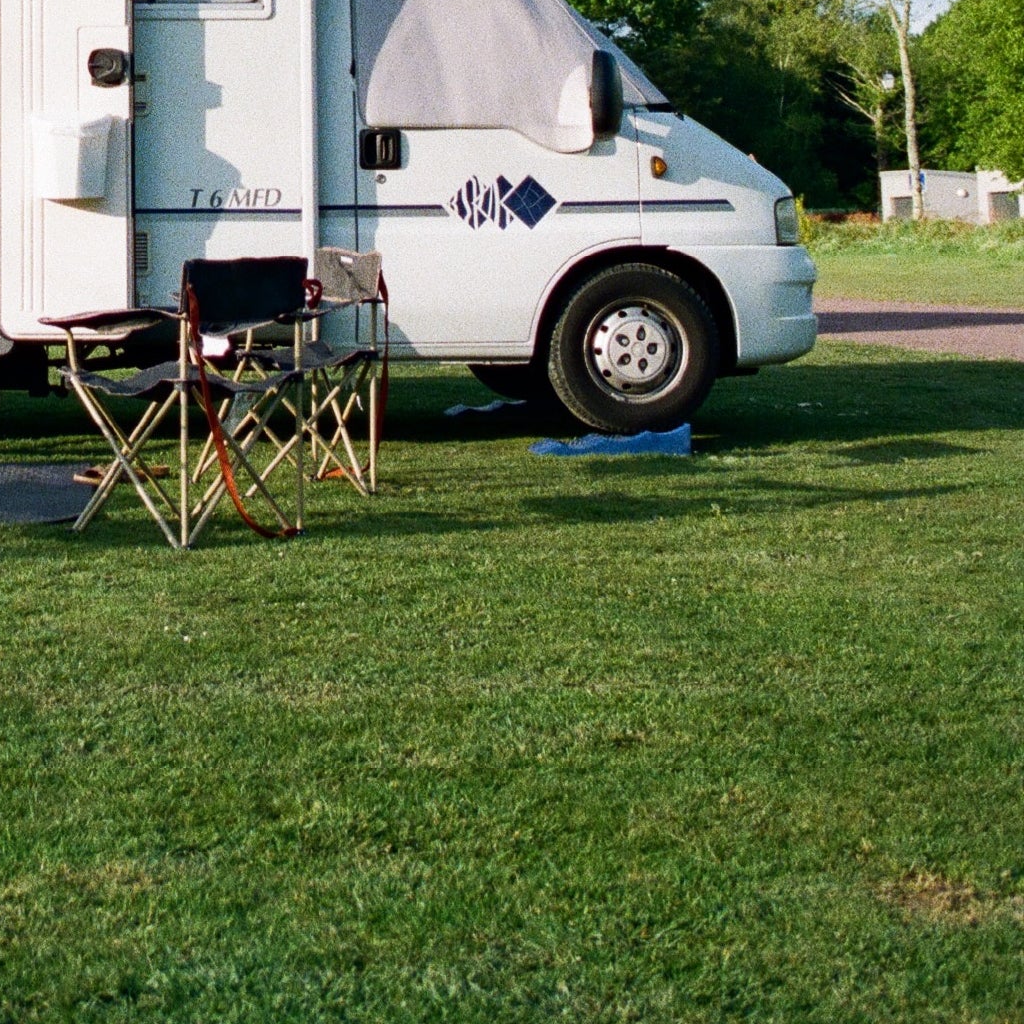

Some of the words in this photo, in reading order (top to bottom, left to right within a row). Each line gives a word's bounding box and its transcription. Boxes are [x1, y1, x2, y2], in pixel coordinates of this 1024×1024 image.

[190, 188, 204, 208] T
[209, 189, 223, 208] 6
[228, 188, 282, 208] MFD
